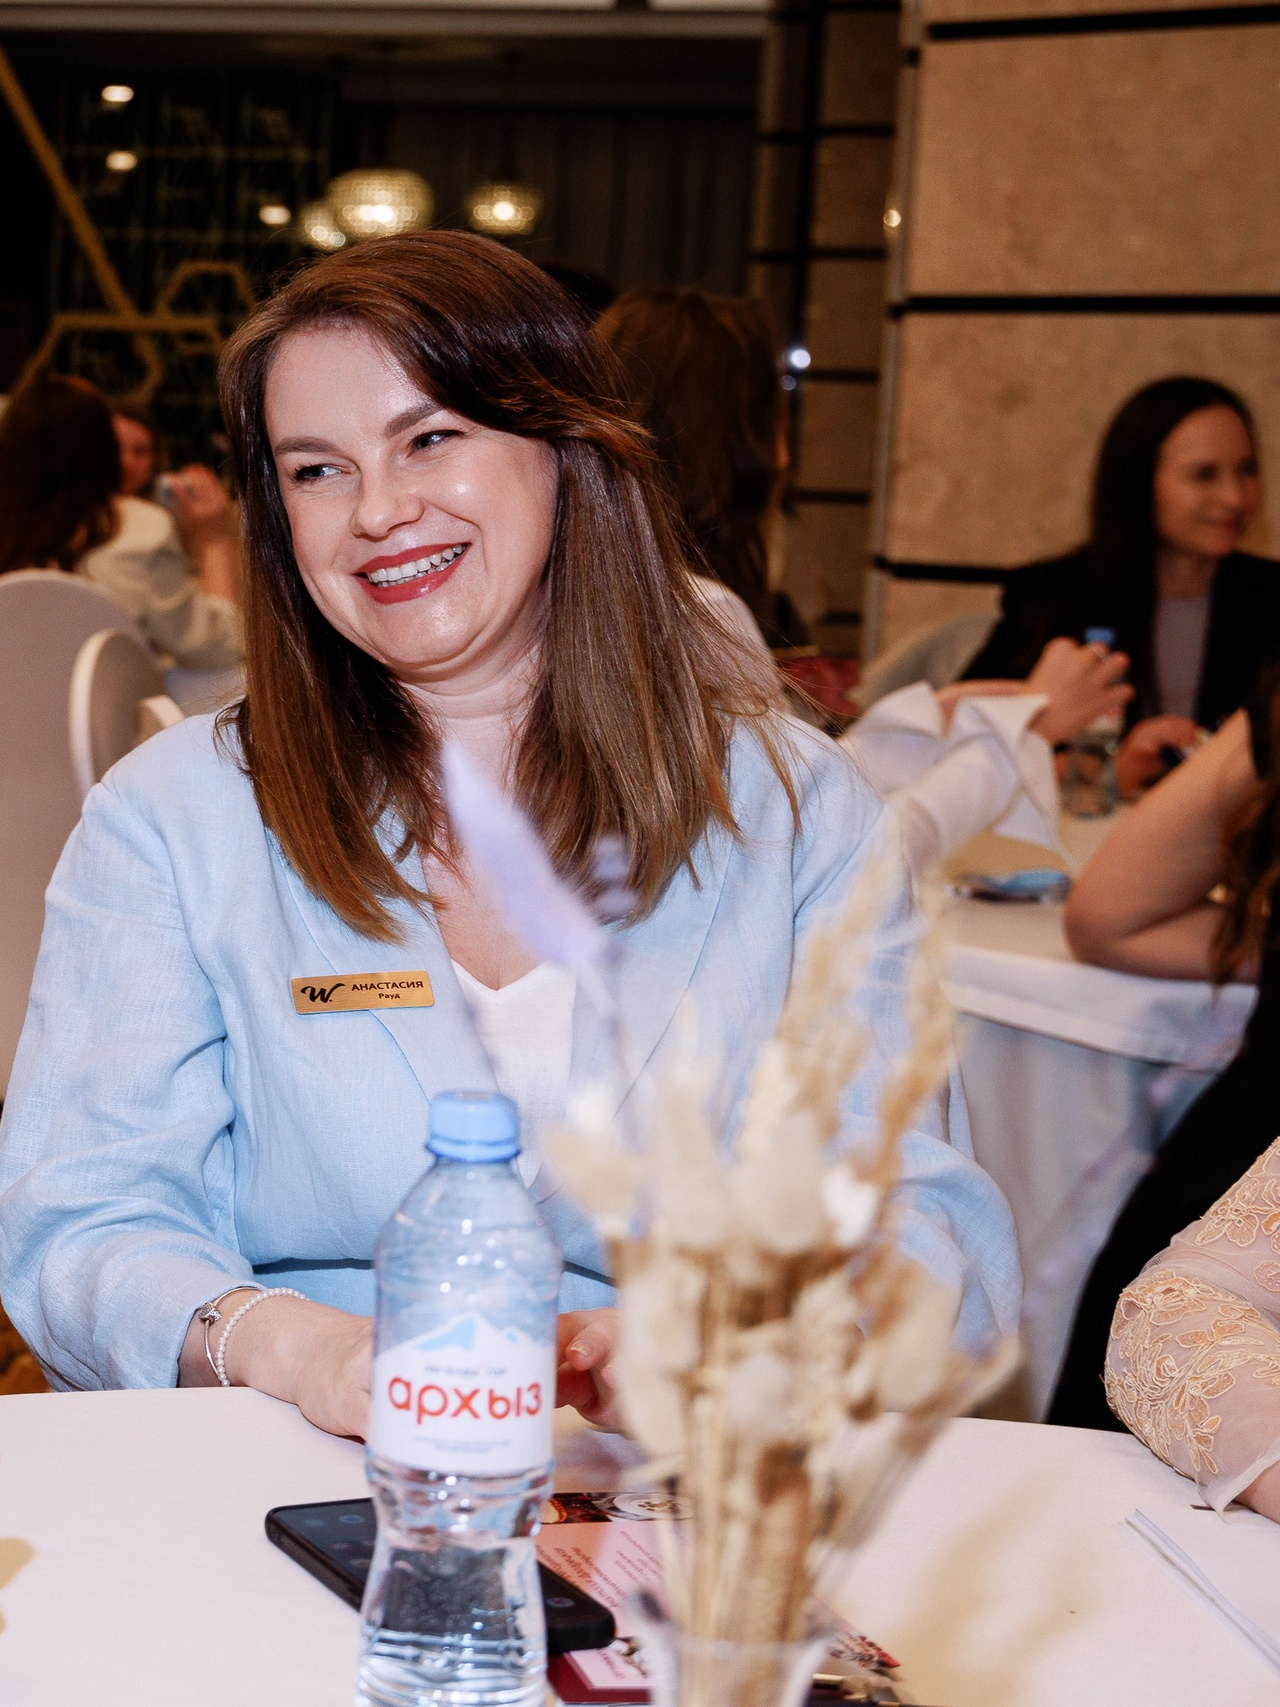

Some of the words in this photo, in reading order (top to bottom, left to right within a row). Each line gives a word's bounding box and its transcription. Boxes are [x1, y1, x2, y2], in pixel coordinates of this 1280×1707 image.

[351, 980, 424, 992] АНАСТАСИЯ
[378, 992, 401, 1000] Рауд
[388, 1376, 542, 1425] архыз
